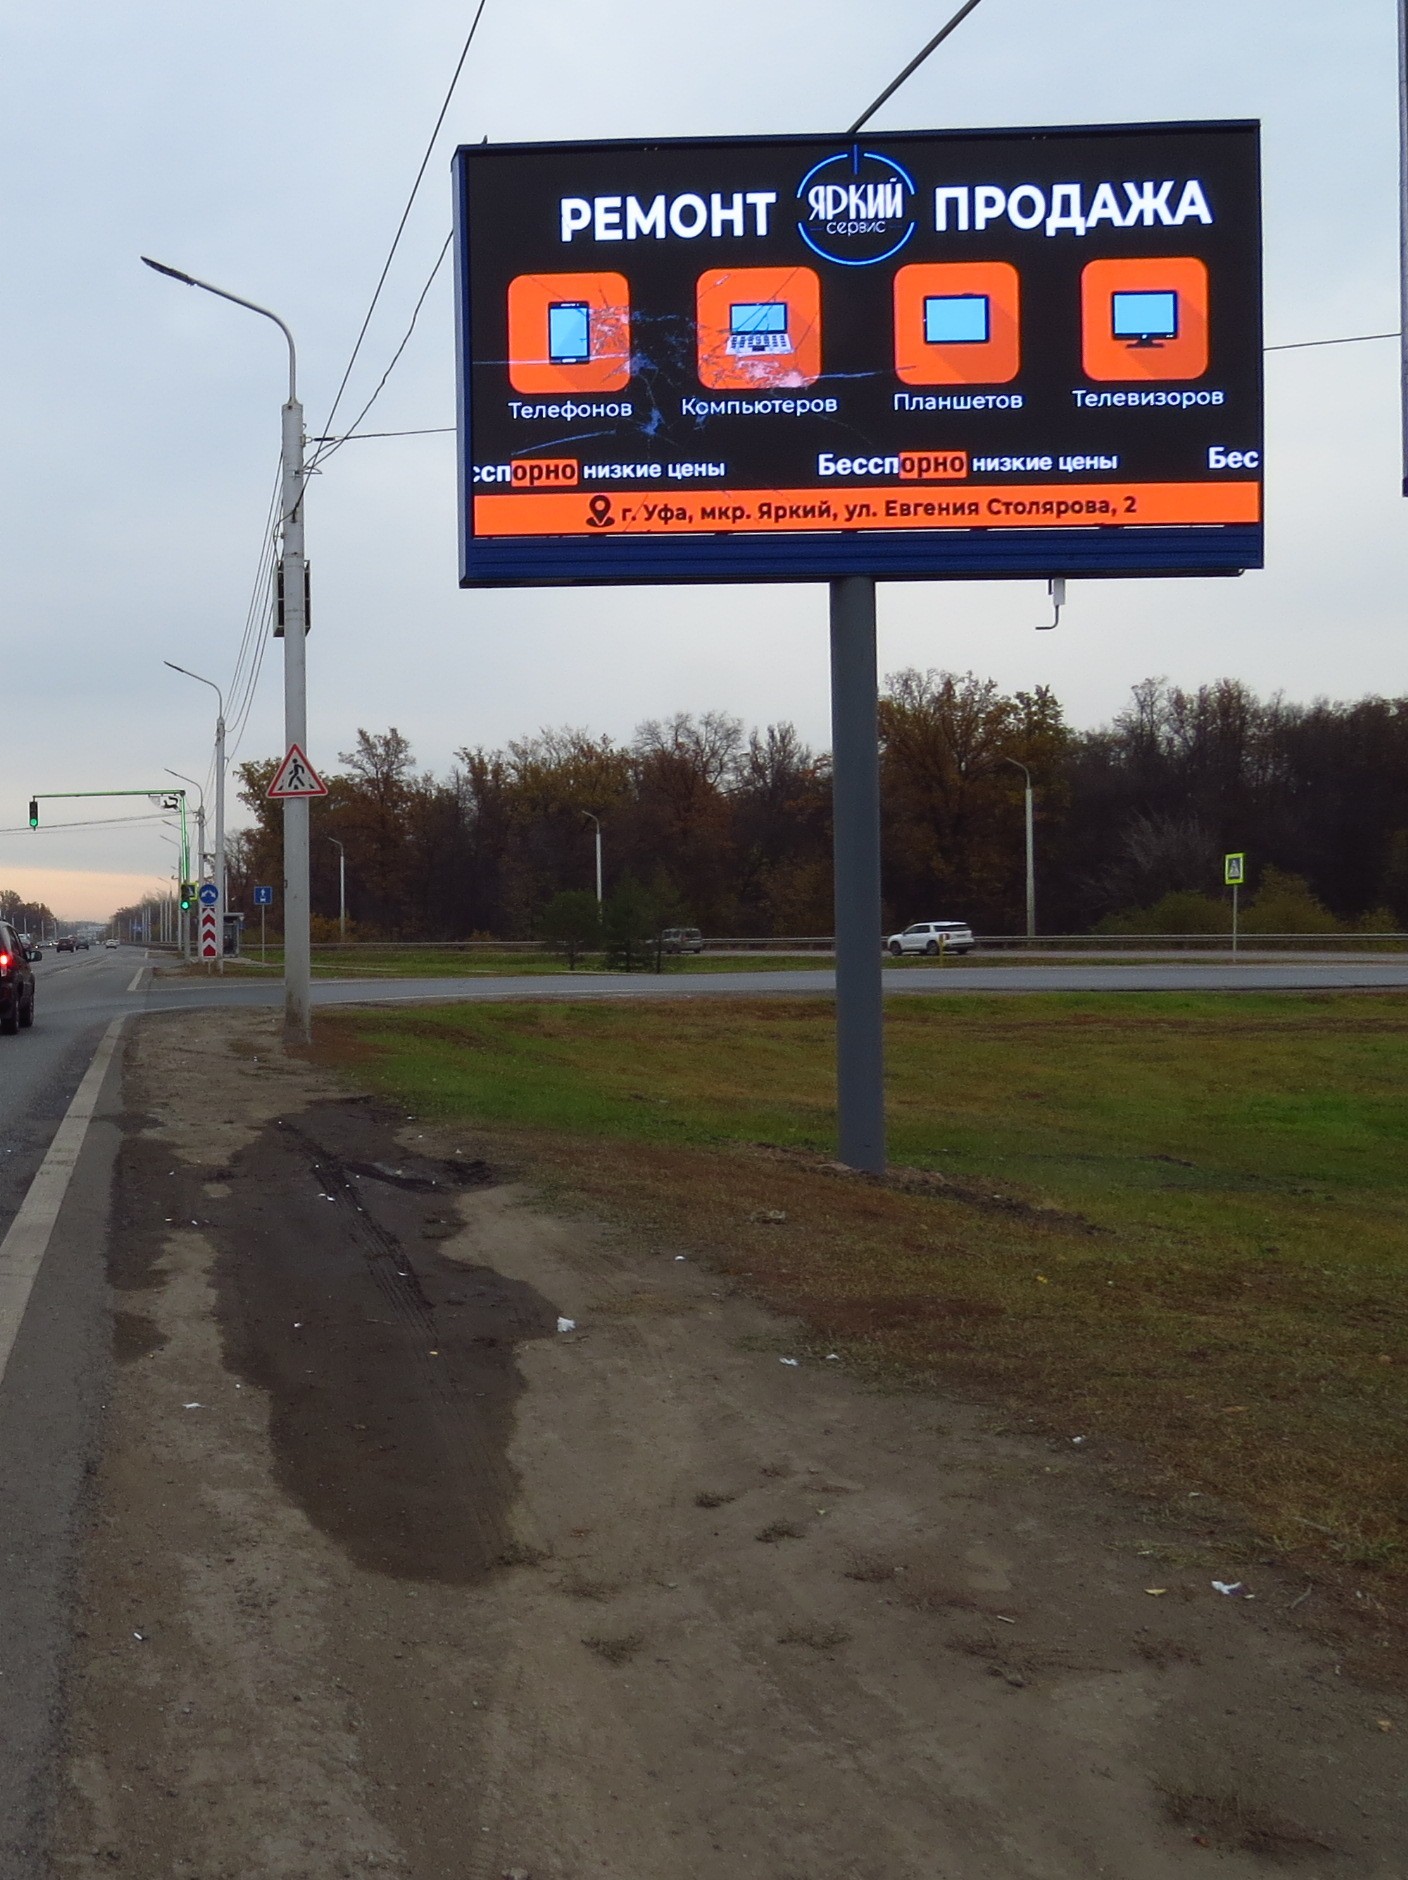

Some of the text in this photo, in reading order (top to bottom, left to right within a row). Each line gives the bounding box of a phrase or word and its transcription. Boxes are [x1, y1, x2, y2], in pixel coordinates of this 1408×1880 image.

[807, 177, 903, 221] ЯРКИЙ
[934, 179, 1214, 238] ПРОДАЖА
[559, 190, 778, 243] РЕМОНТ
[826, 221, 887, 237] сервис
[682, 396, 839, 418] Компьютеров
[894, 393, 1024, 412] Планшетов
[1072, 389, 1225, 411] Телевизоров
[508, 401, 634, 422] Телефонов
[583, 464, 662, 479] низкие
[667, 461, 726, 481] цены
[818, 452, 1118, 478] Бесспорно низкие цены
[621, 496, 1137, 523] г. Уфа, мкр. Яркий, ул. Евгения Столярова, 2
